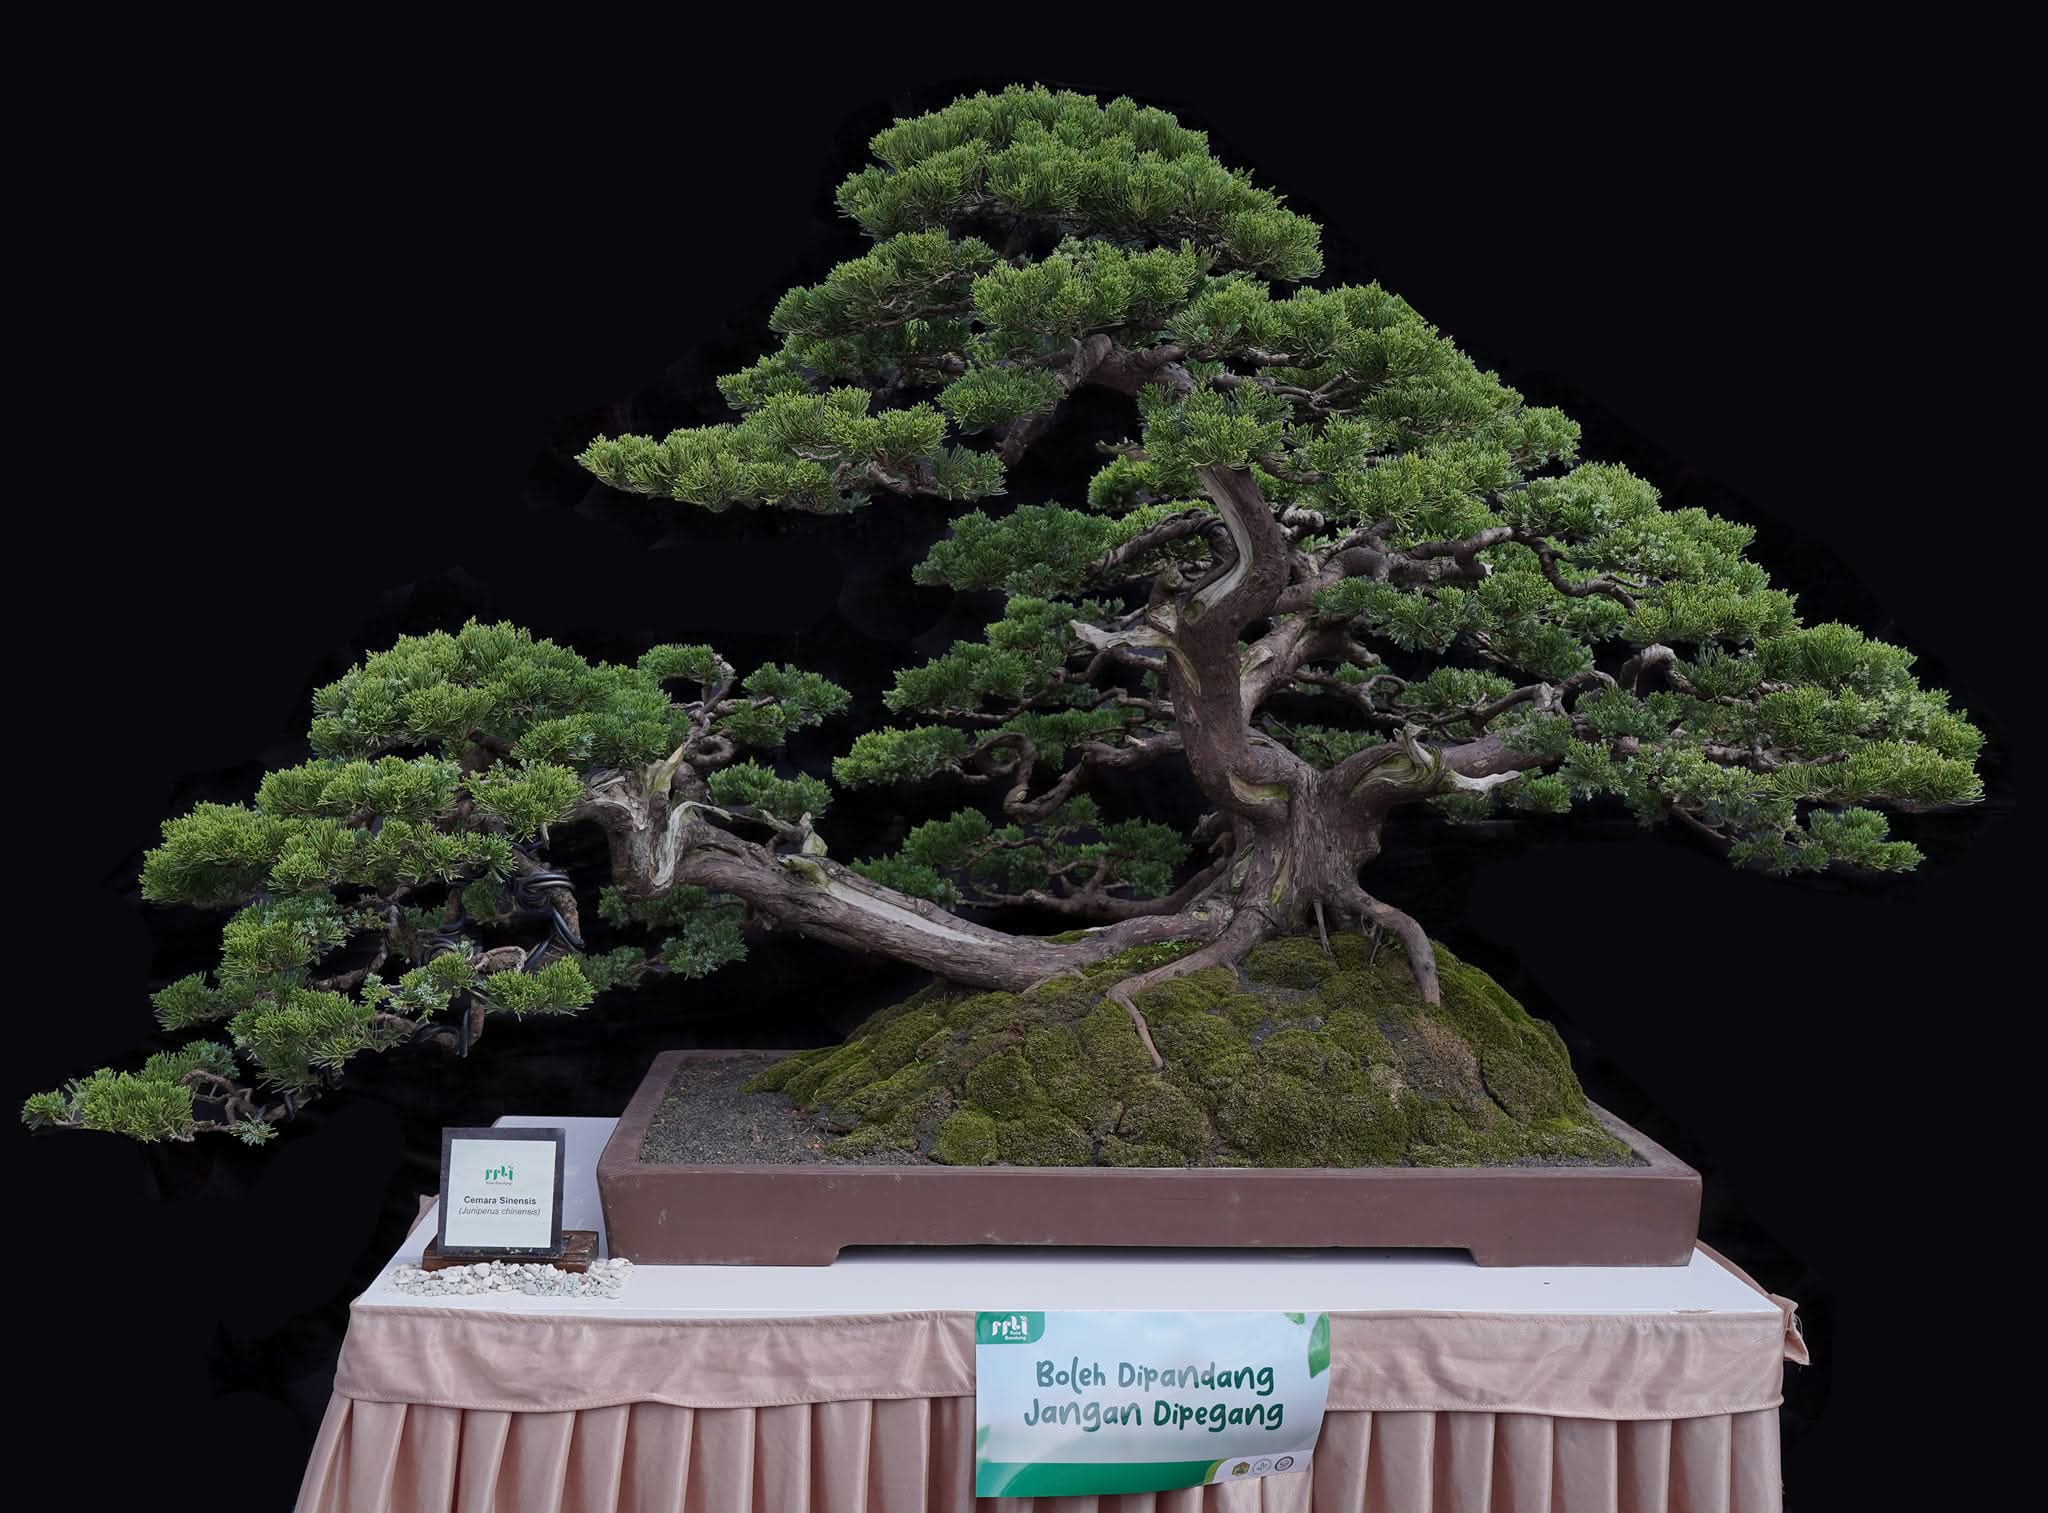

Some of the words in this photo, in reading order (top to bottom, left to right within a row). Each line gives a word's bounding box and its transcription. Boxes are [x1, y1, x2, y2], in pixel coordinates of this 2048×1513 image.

[464, 1196, 497, 1205] Cemara
[499, 1196, 537, 1205] Sinensis
[458, 1207, 499, 1216] (Juniperus
[501, 1207, 541, 1217] chinensis)
[1036, 1356, 1106, 1395] Boleh
[1118, 1361, 1275, 1396] Dipandang
[1023, 1398, 1142, 1433] Jangan
[1153, 1400, 1284, 1433] Dipegang
